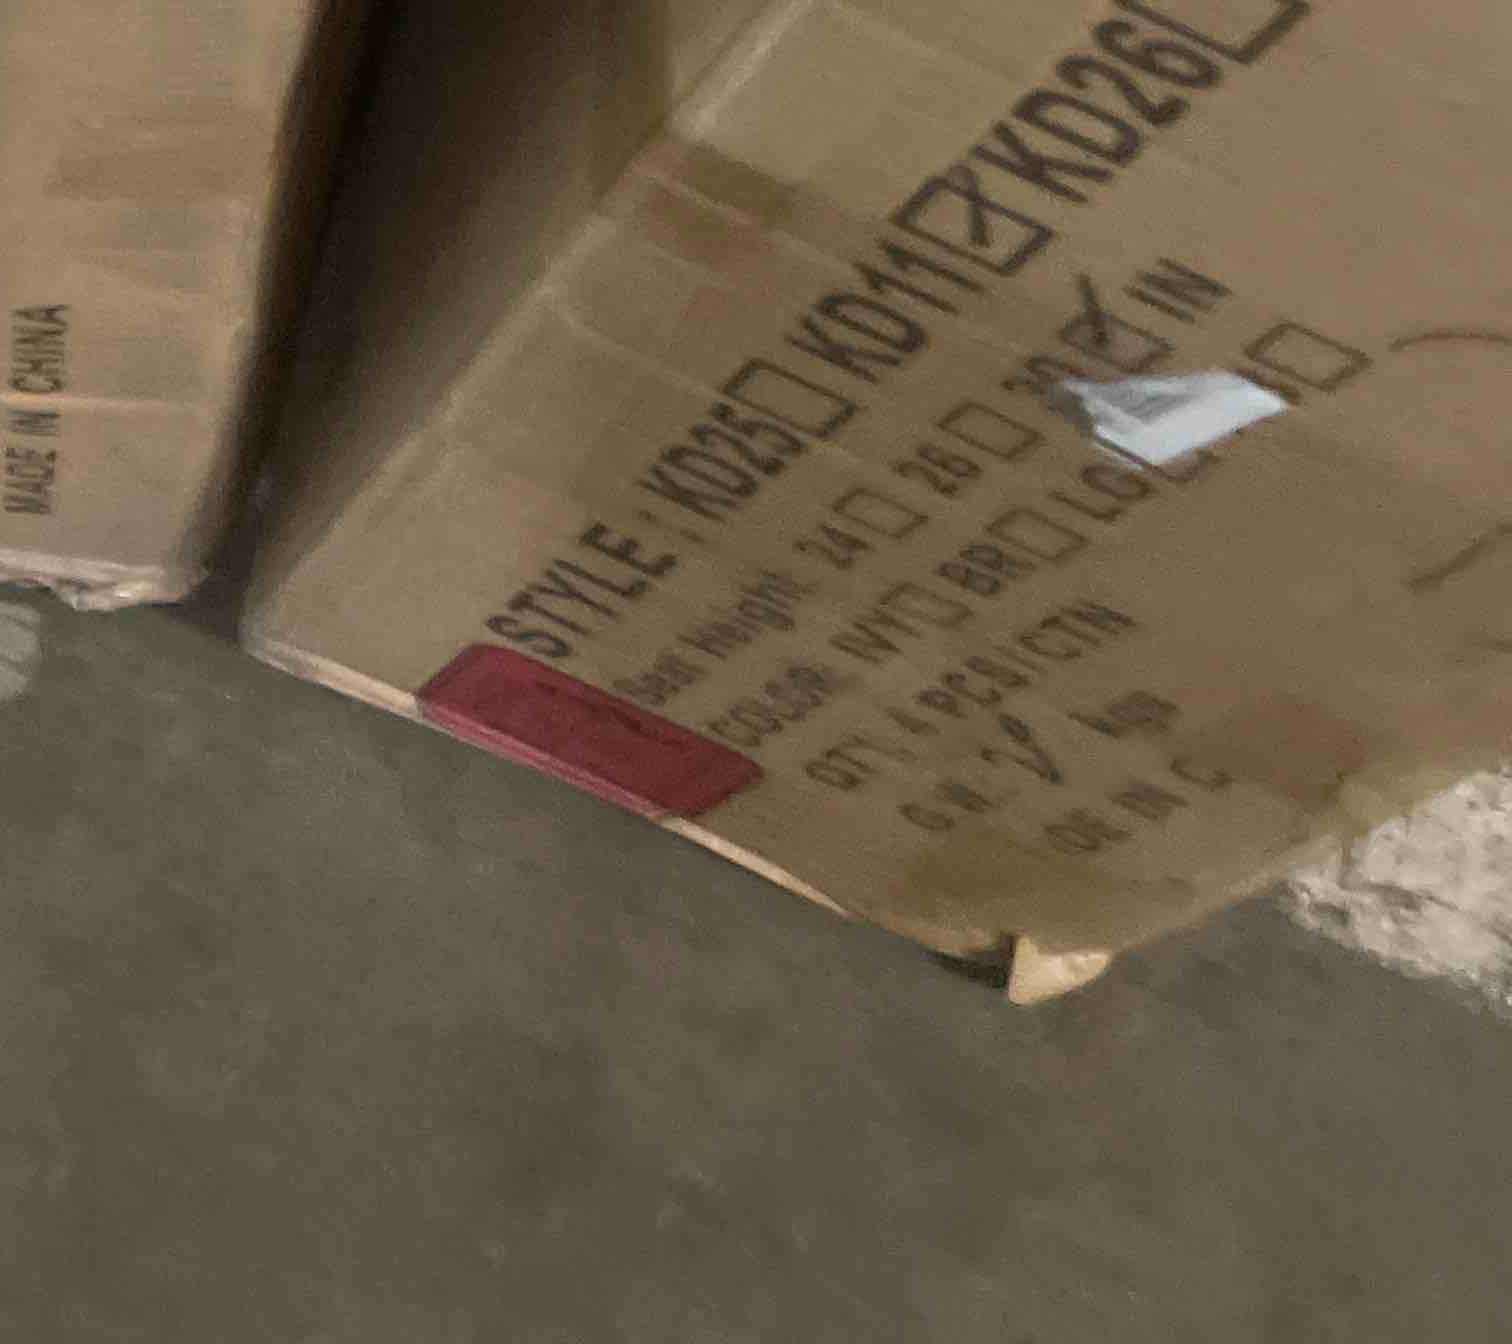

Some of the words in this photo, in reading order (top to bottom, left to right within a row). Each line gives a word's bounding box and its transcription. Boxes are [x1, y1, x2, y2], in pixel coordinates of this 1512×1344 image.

[783, 237, 986, 384] KD11
[971, 19, 1222, 206] KD26
[1121, 256, 1236, 326] IN
